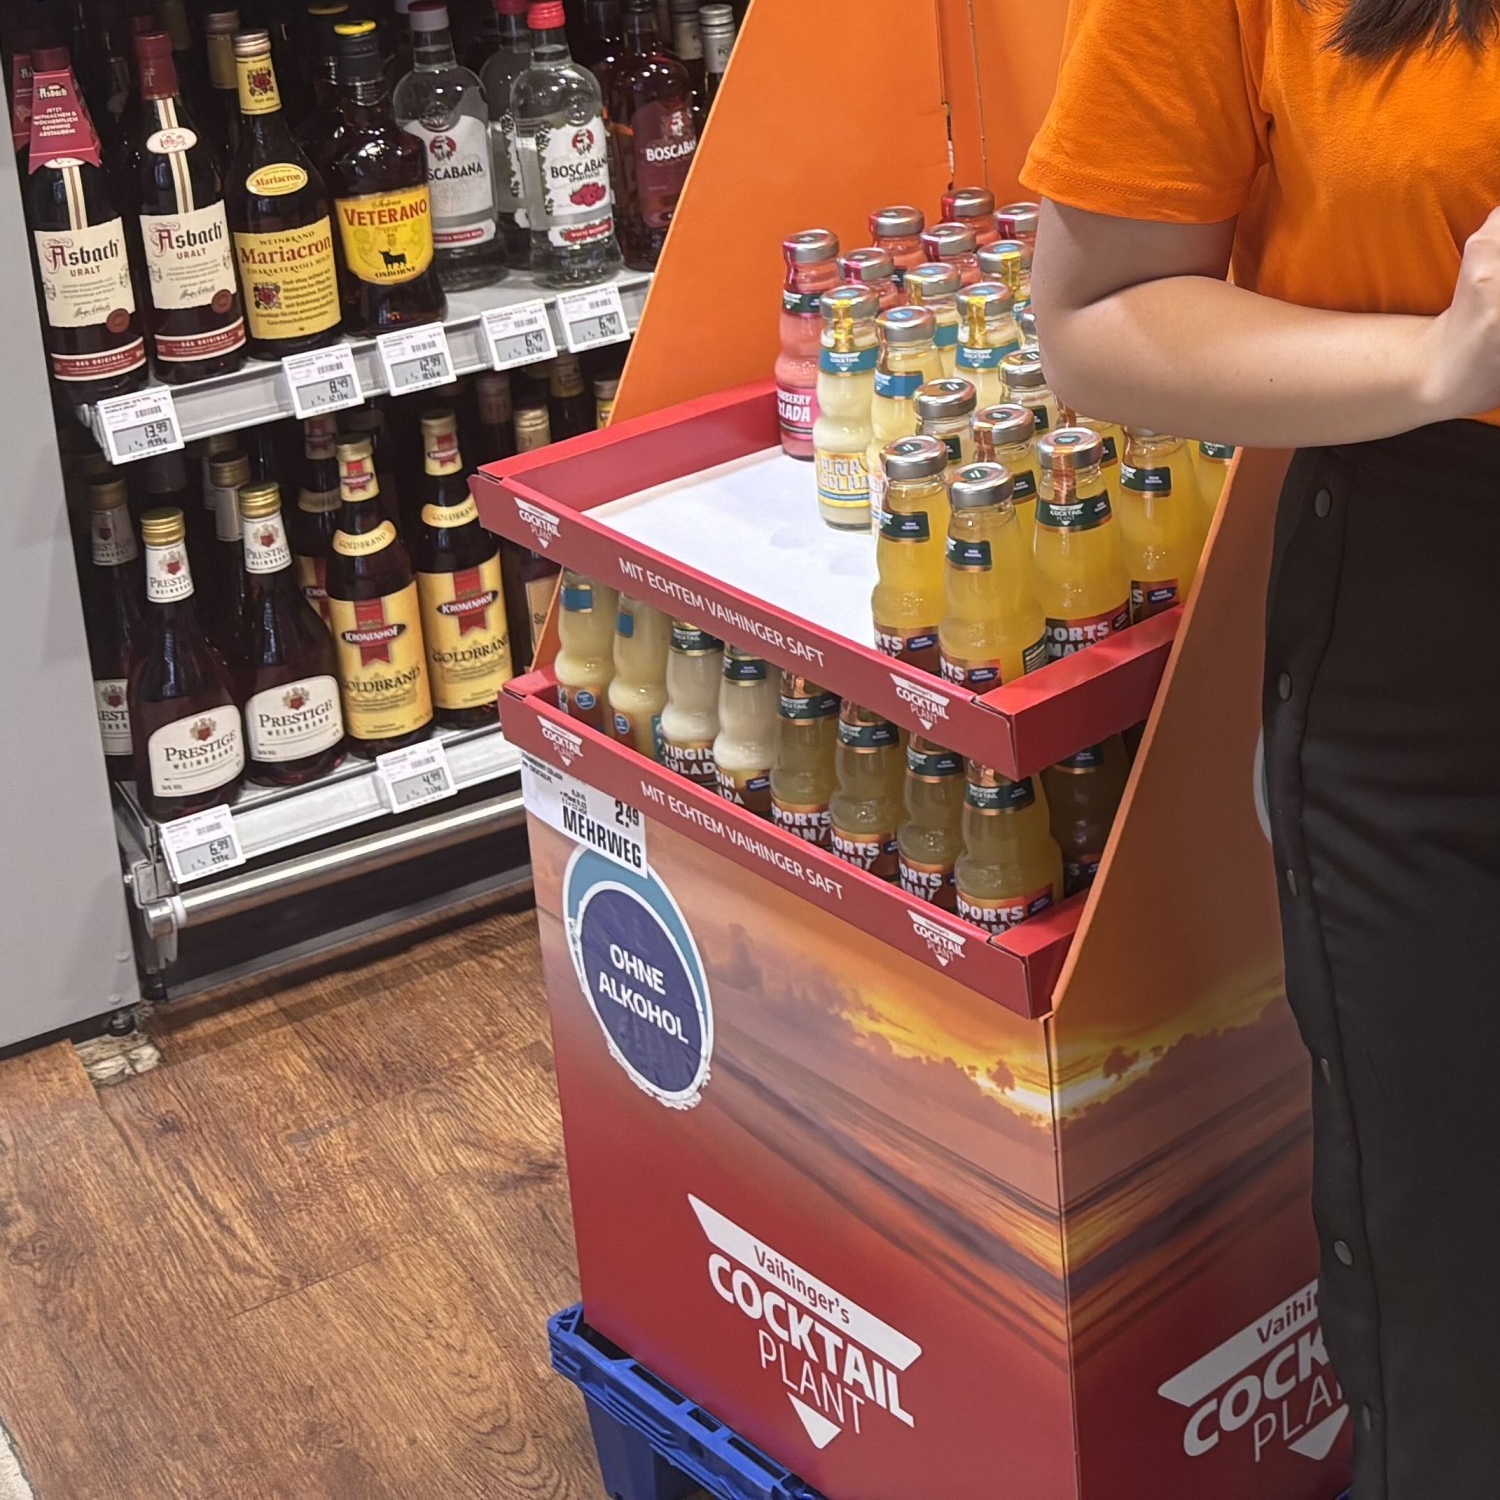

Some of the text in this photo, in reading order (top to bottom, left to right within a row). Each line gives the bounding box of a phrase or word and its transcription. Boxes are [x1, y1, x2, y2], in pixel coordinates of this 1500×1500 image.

[254, 174, 302, 188] Mariacron
[343, 198, 428, 227] VETERANO
[155, 222, 223, 252] Asbach
[176, 247, 207, 260] URALT
[239, 236, 332, 266] Mariacron
[344, 625, 405, 642] KRONENHOF
[619, 557, 824, 668] MIT ECHTEM VAIHINGER SAFT
[258, 699, 334, 730] PRESTIGE
[615, 799, 639, 828] 2.49
[563, 805, 641, 868] MEHRWEG
[640, 779, 843, 900] MIT ECHTEM VAIHINGER SAFT
[609, 943, 666, 996] OHNE
[599, 971, 689, 1045] ALKOHOL
[753, 1243, 851, 1326] Vaihinger's
[707, 1252, 916, 1429] COCKTAIL
[757, 1327, 866, 1436] PLANT
